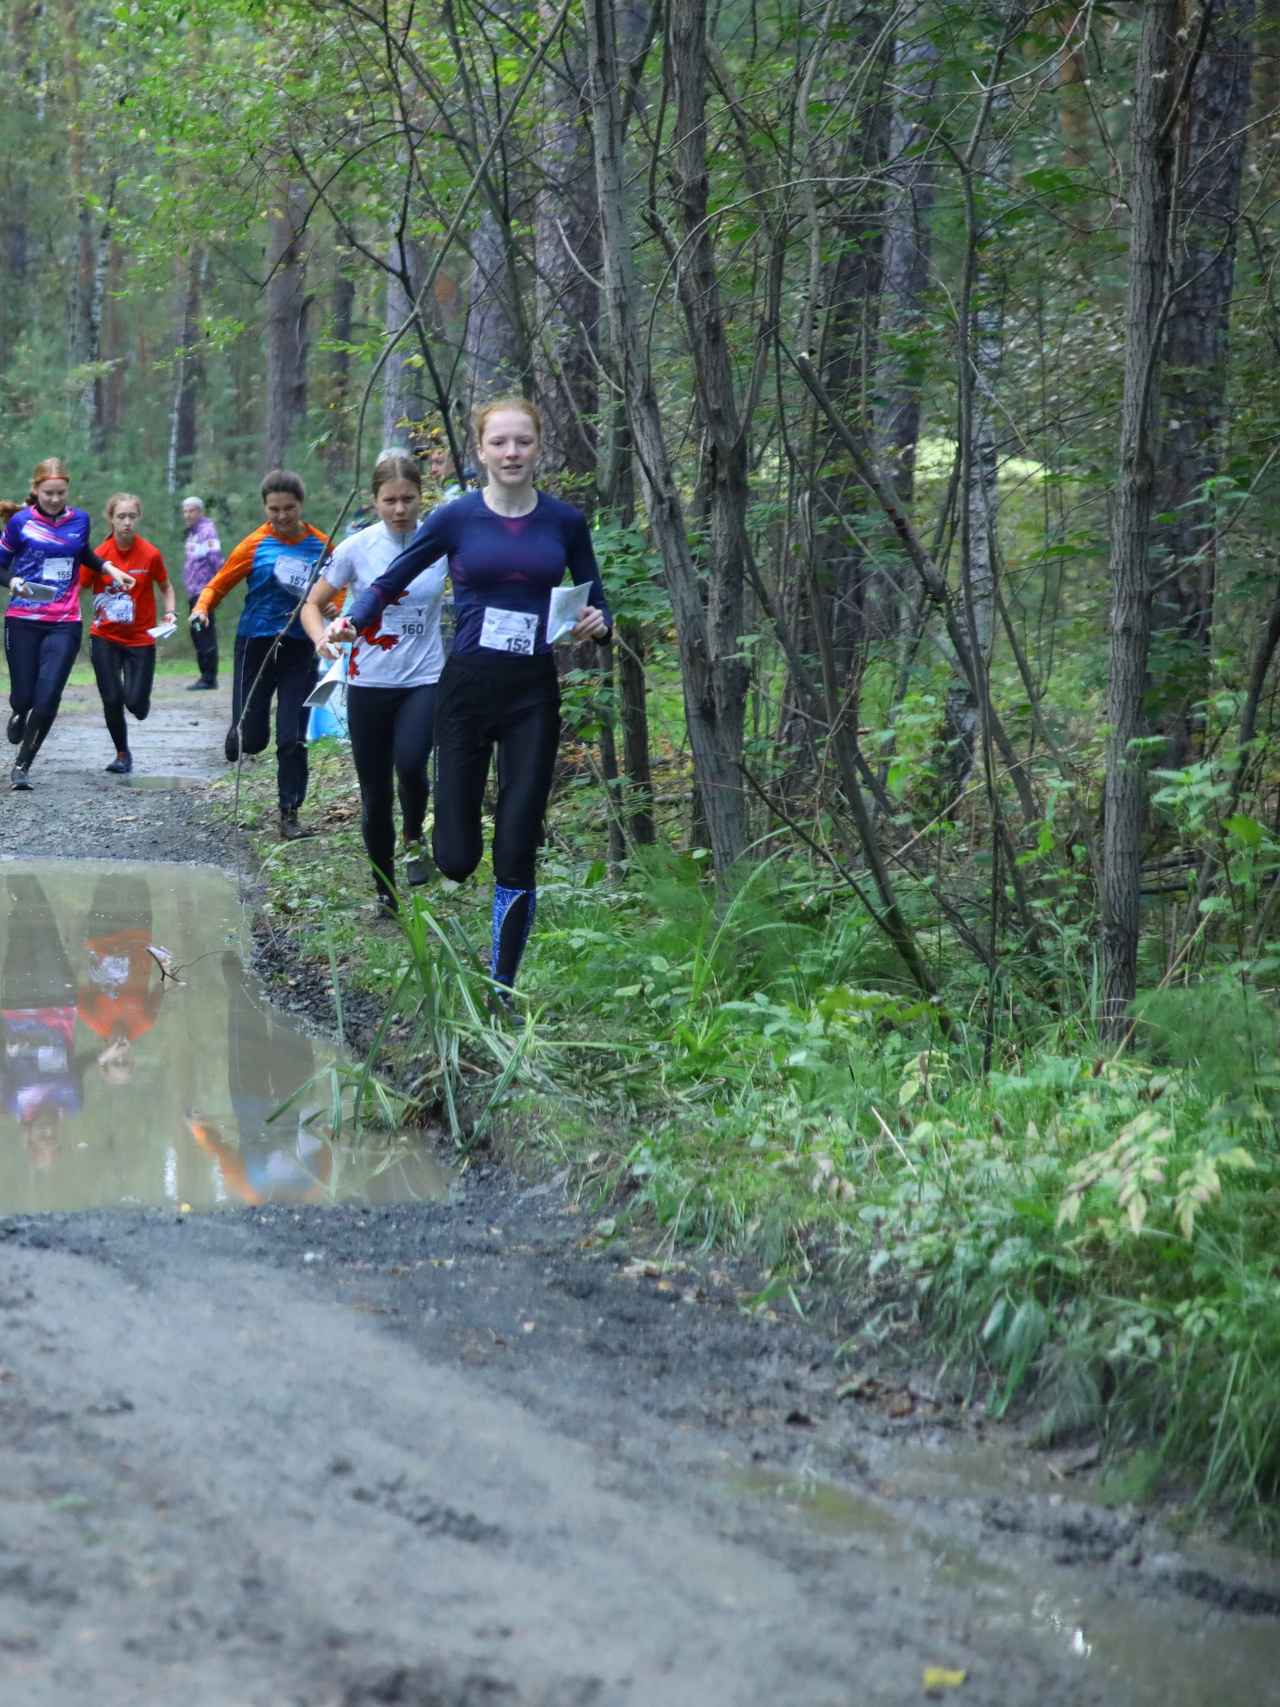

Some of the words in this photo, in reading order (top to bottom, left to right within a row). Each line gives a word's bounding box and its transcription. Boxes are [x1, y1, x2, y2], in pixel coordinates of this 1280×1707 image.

[57, 570, 72, 579] 155
[290, 574, 308, 587] 157
[401, 623, 425, 635] 160
[506, 637, 532, 655] 152
